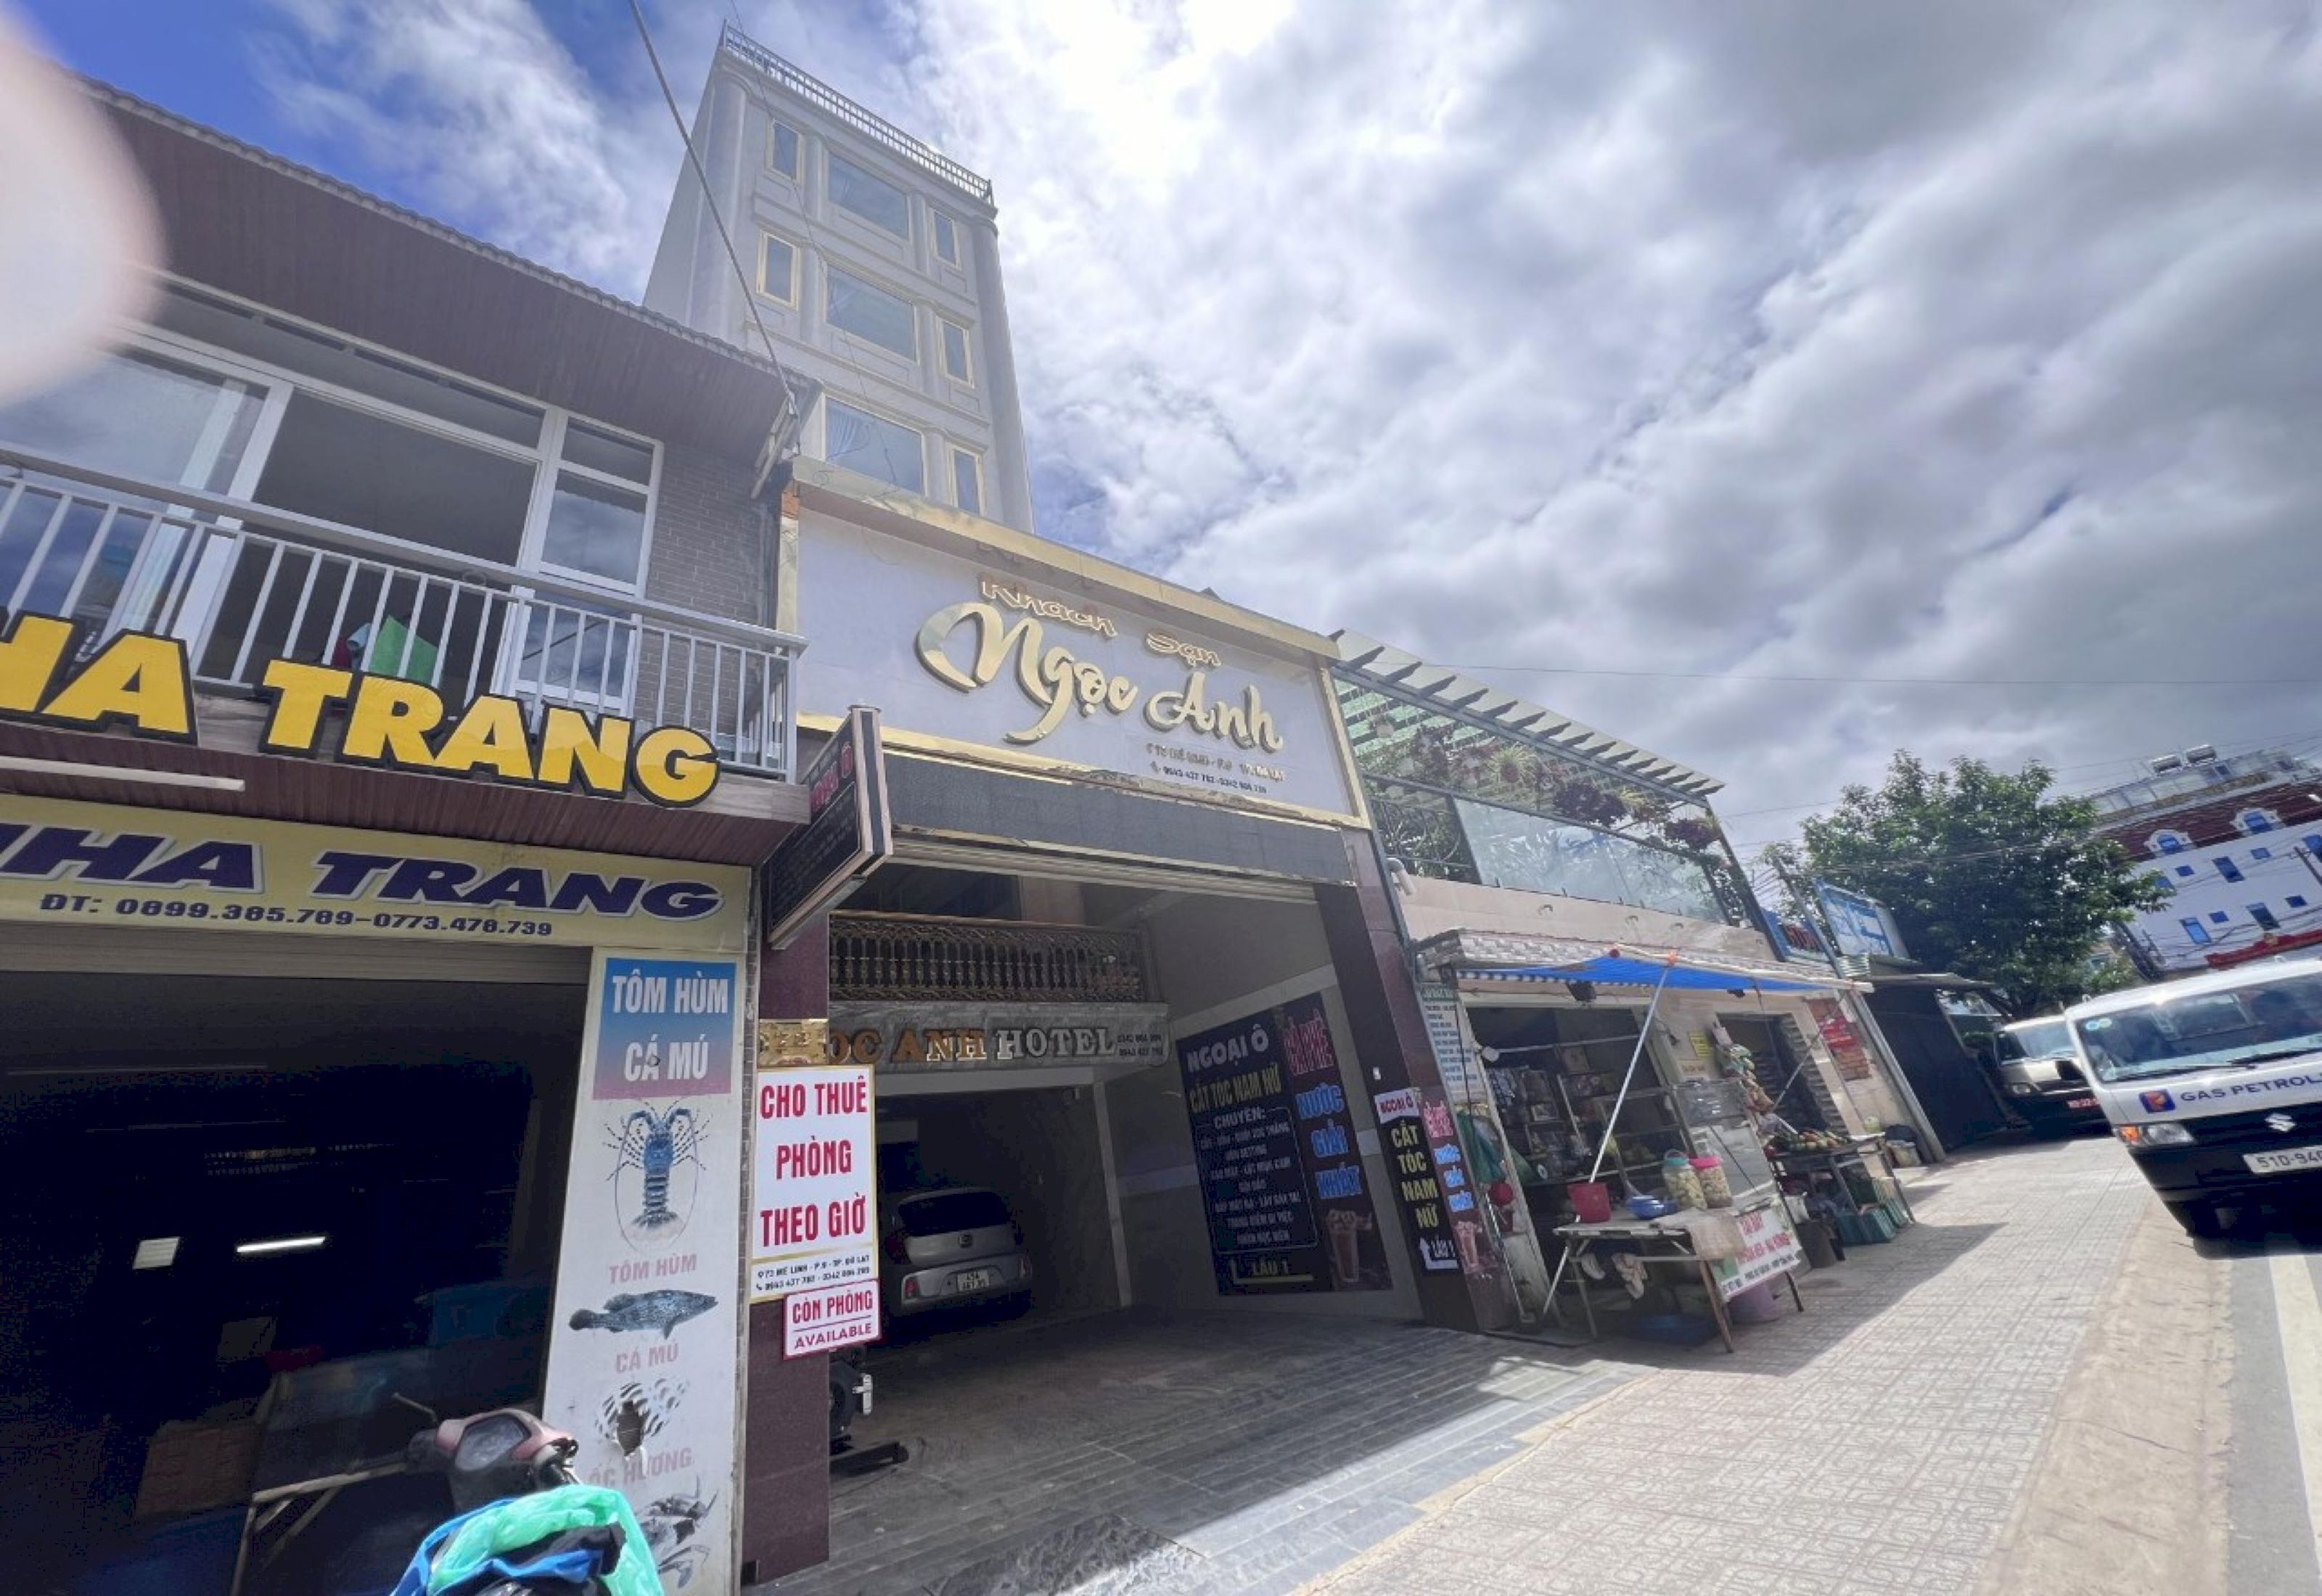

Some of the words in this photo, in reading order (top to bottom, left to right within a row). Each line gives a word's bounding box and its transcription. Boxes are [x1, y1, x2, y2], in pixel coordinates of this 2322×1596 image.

[916, 602, 1138, 744] Ngọc
[260, 657, 720, 807] TRANG
[0, 822, 259, 891] HA
[312, 852, 721, 918] TRANG
[40, 893, 102, 913] ĐT:
[612, 968, 666, 1015] TÔM
[673, 970, 729, 1015] HÙM
[623, 1032, 661, 1082] CÁ
[667, 1033, 710, 1081] MÚ
[891, 1027, 987, 1062] ANH
[993, 1027, 1117, 1061] HOTEL
[1186, 1034, 1249, 1073] NGOẠI
[1251, 1023, 1269, 1053] Ô
[760, 1085, 806, 1120] CHO
[815, 1075, 868, 1115] THUÊ
[1210, 1077, 1233, 1109] TÓC
[1233, 1071, 1263, 1103] NAM
[2180, 1087, 2226, 1101] GAS
[2229, 1073, 2322, 1095] PETROL
[1390, 1119, 1419, 1149] CẮT
[775, 1135, 853, 1180] PHÒNG
[1398, 1149, 1427, 1175] TÓC
[1401, 1177, 1440, 1202] NAM
[760, 1204, 820, 1248] THEO
[828, 1191, 867, 1238] GIỜ
[1415, 1202, 1440, 1229] NỮ
[609, 1258, 648, 1285] TÔM
[656, 1253, 697, 1276] HÙM
[792, 1296, 821, 1324] CÒN
[826, 1289, 873, 1317] PHÒNG
[794, 1323, 871, 1349] AVAILABLE
[616, 1346, 641, 1375] CÁ
[649, 1341, 679, 1365] MÚ
